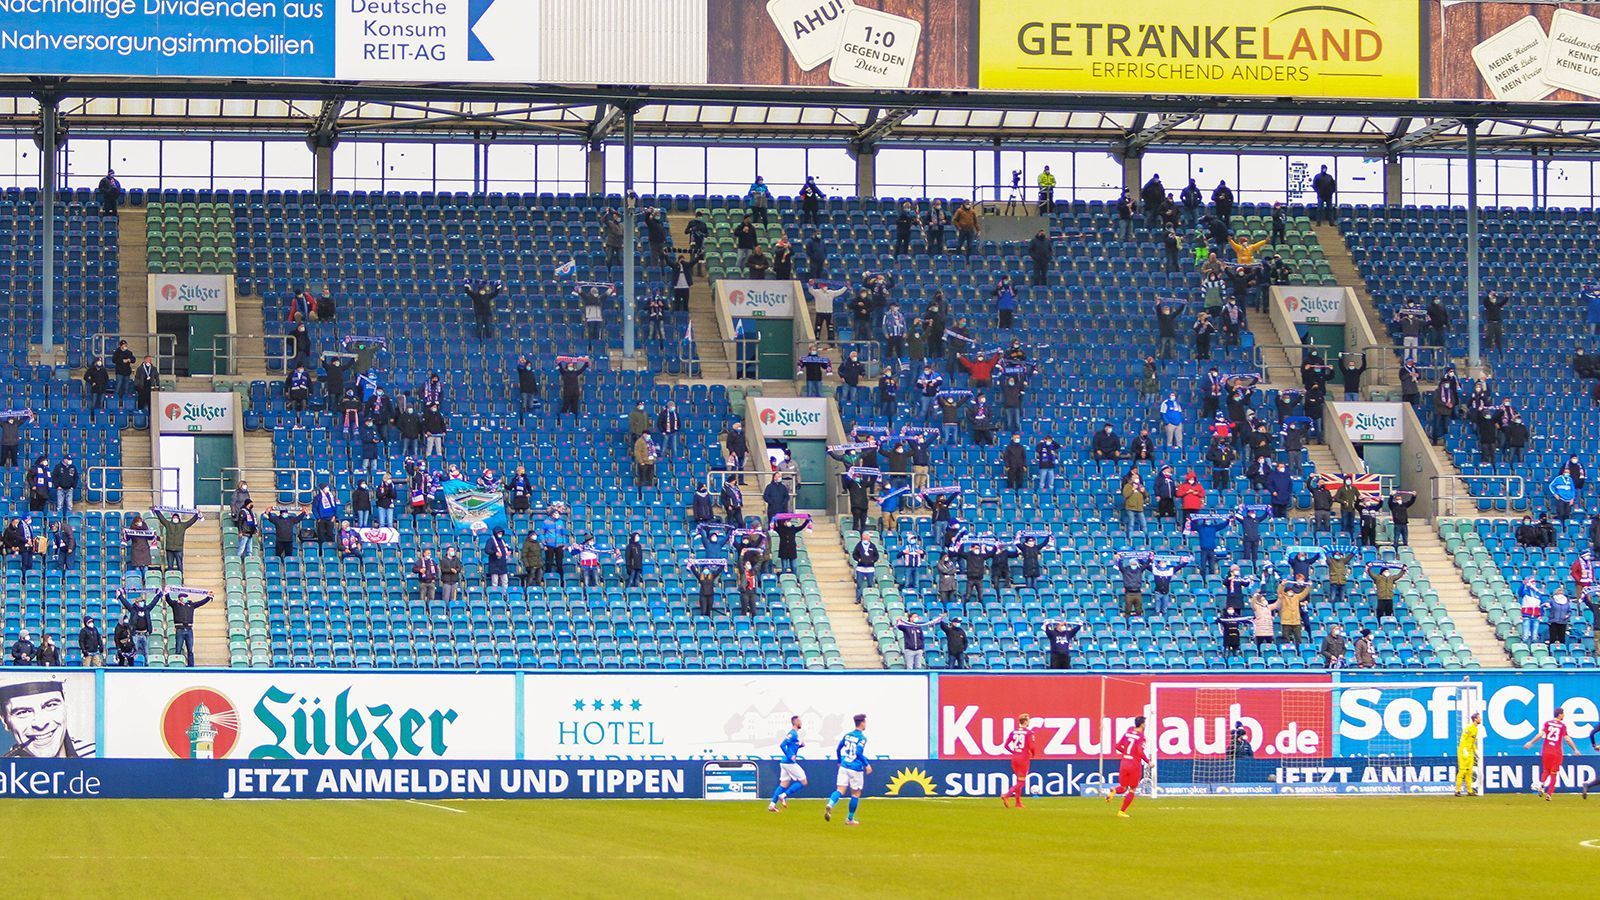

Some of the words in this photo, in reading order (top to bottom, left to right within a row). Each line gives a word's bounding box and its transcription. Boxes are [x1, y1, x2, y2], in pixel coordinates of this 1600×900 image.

[144, 0, 276, 17] Dividenden
[283, 1, 323, 18] aus
[351, 0, 447, 14] Deutsche
[793, 0, 846, 39] AHU!
[364, 20, 446, 38] Konsum
[864, 26, 895, 47] 1:0
[2, 30, 314, 56] Nahversorgungsimmobilien
[1017, 22, 1383, 62] GETRÄNKELAND
[364, 44, 446, 61] REIT-AG
[844, 43, 880, 60] GEGEN
[882, 53, 905, 66] DEN
[1568, 49, 1598, 63] KENNT
[854, 58, 888, 75] Durst
[1488, 53, 1513, 71] MEINE
[1556, 57, 1582, 72] KEINE
[1092, 62, 1225, 80] ERFRISCHEND
[1231, 65, 1309, 82] ANDERS
[1494, 64, 1519, 82] MEINE
[1501, 78, 1522, 93] MEIN
[179, 284, 220, 302] Lübzer
[183, 402, 226, 421] Lübzer
[778, 408, 820, 426] Lübzer
[1355, 412, 1397, 430] Lübzer
[248, 685, 459, 760] Lübzer
[557, 721, 665, 745] HOTEL
[1013, 733, 1025, 749] 29
[1546, 725, 1560, 741] 23
[1126, 737, 1135, 754] 7
[223, 768, 309, 798] JETZT
[316, 768, 490, 793] ANMELDEN
[500, 768, 569, 793] UND
[577, 768, 684, 793] TIPPEN
[1275, 766, 1353, 784] JETZT
[1361, 765, 1523, 788] ANMEEN
[1165, 784, 1207, 794] sunmaker
[1230, 784, 1272, 794] sunmaker
[1295, 784, 1337, 794] sunmaker
[1360, 784, 1402, 794] sunmaker
[1423, 784, 1464, 794] sunmak
